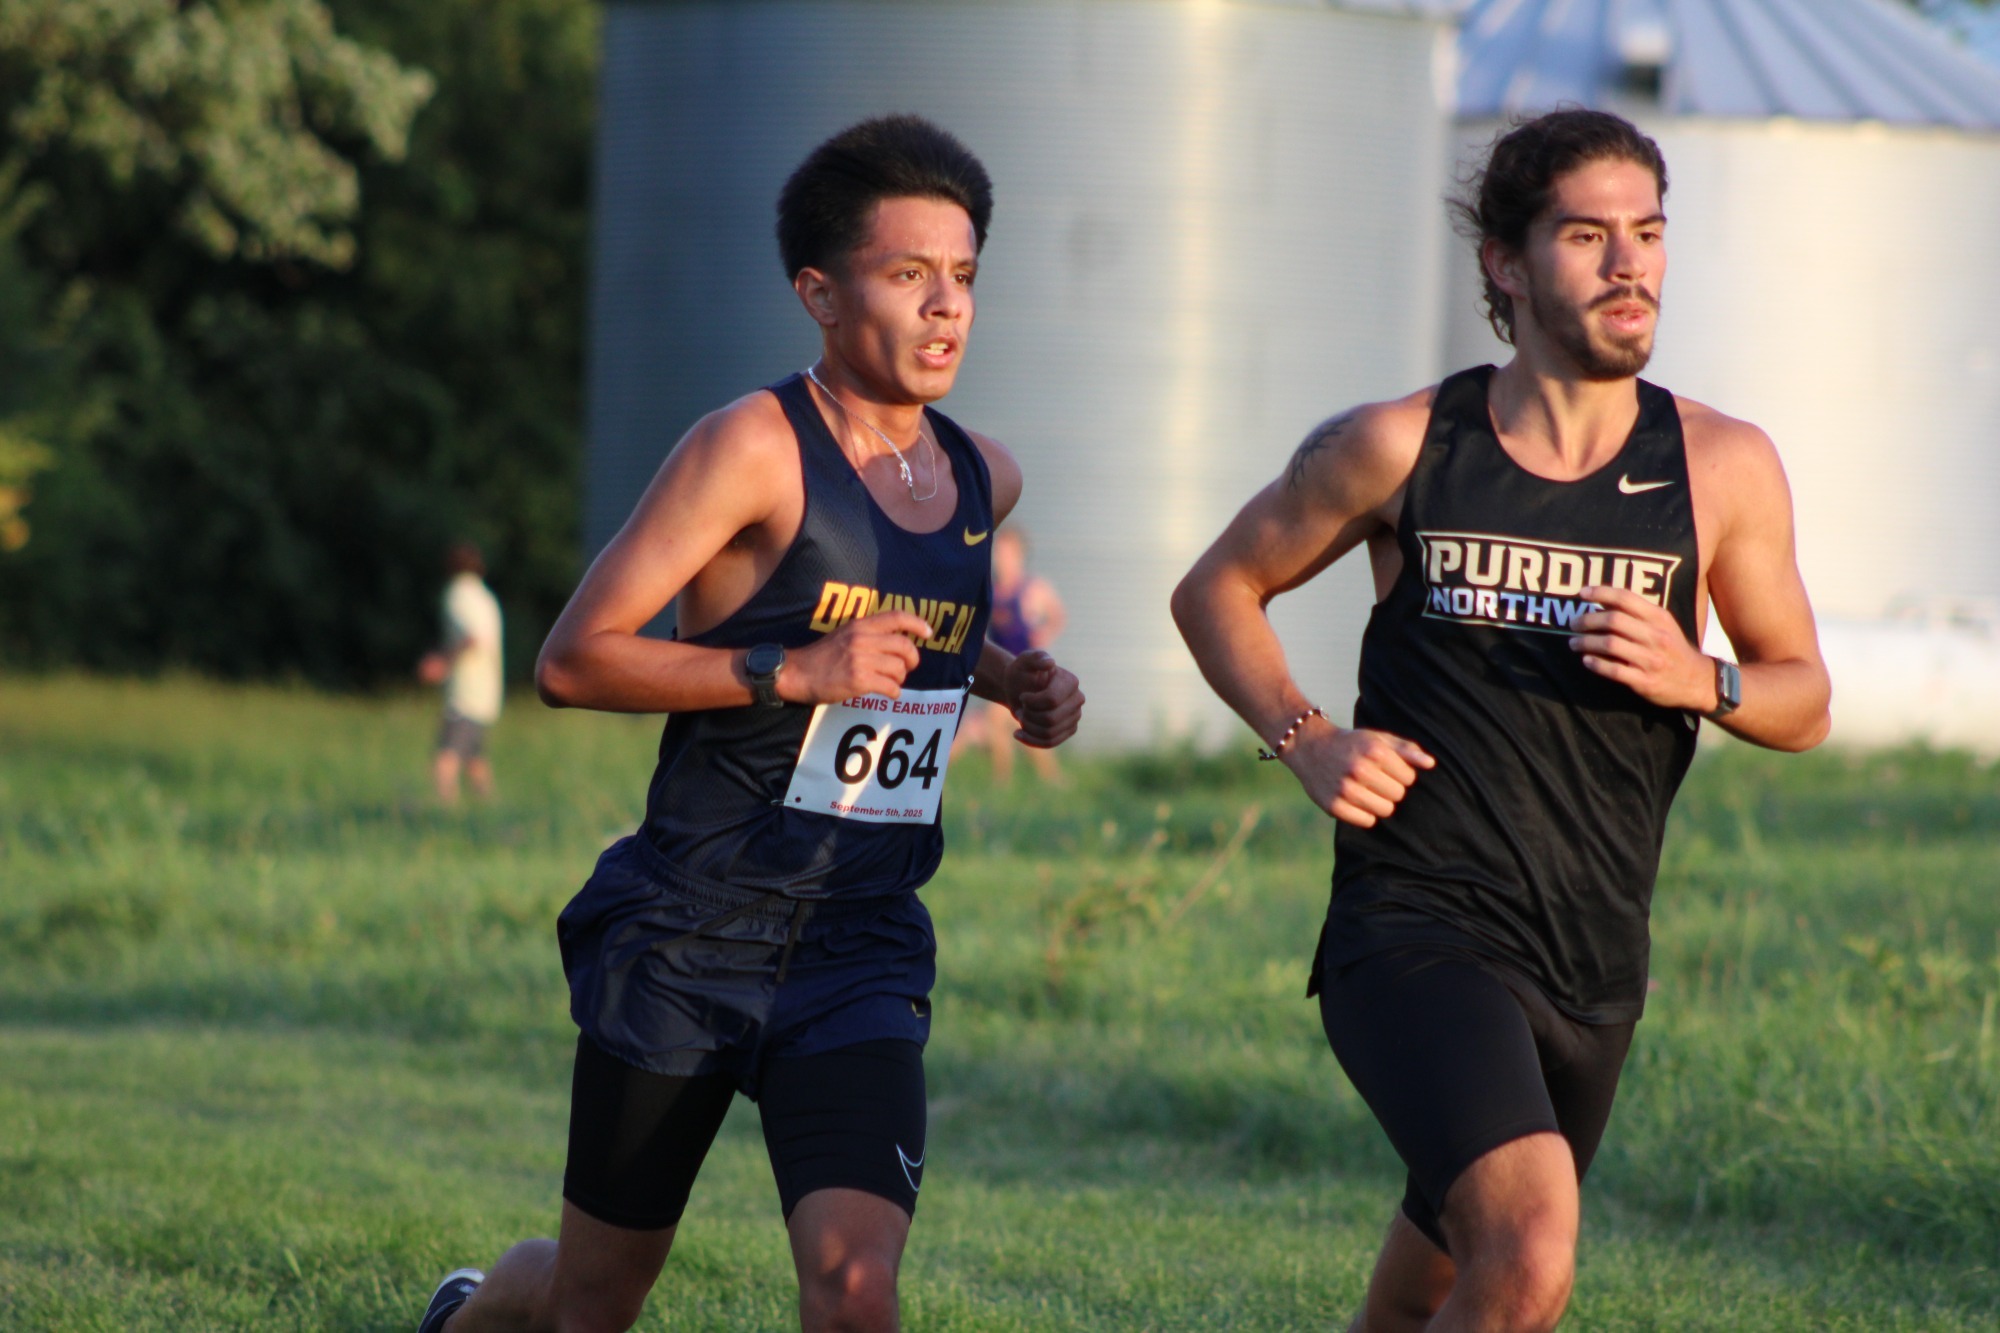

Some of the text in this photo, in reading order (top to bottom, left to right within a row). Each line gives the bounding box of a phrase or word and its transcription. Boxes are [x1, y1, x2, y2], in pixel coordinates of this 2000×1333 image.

[1429, 540, 1664, 606] PURDUE
[1431, 586, 1604, 627] NORTHW
[842, 696, 957, 715] LEWIS EARLYBIRD
[834, 724, 942, 790] 664
[830, 801, 923, 818] September 5th, 2025
